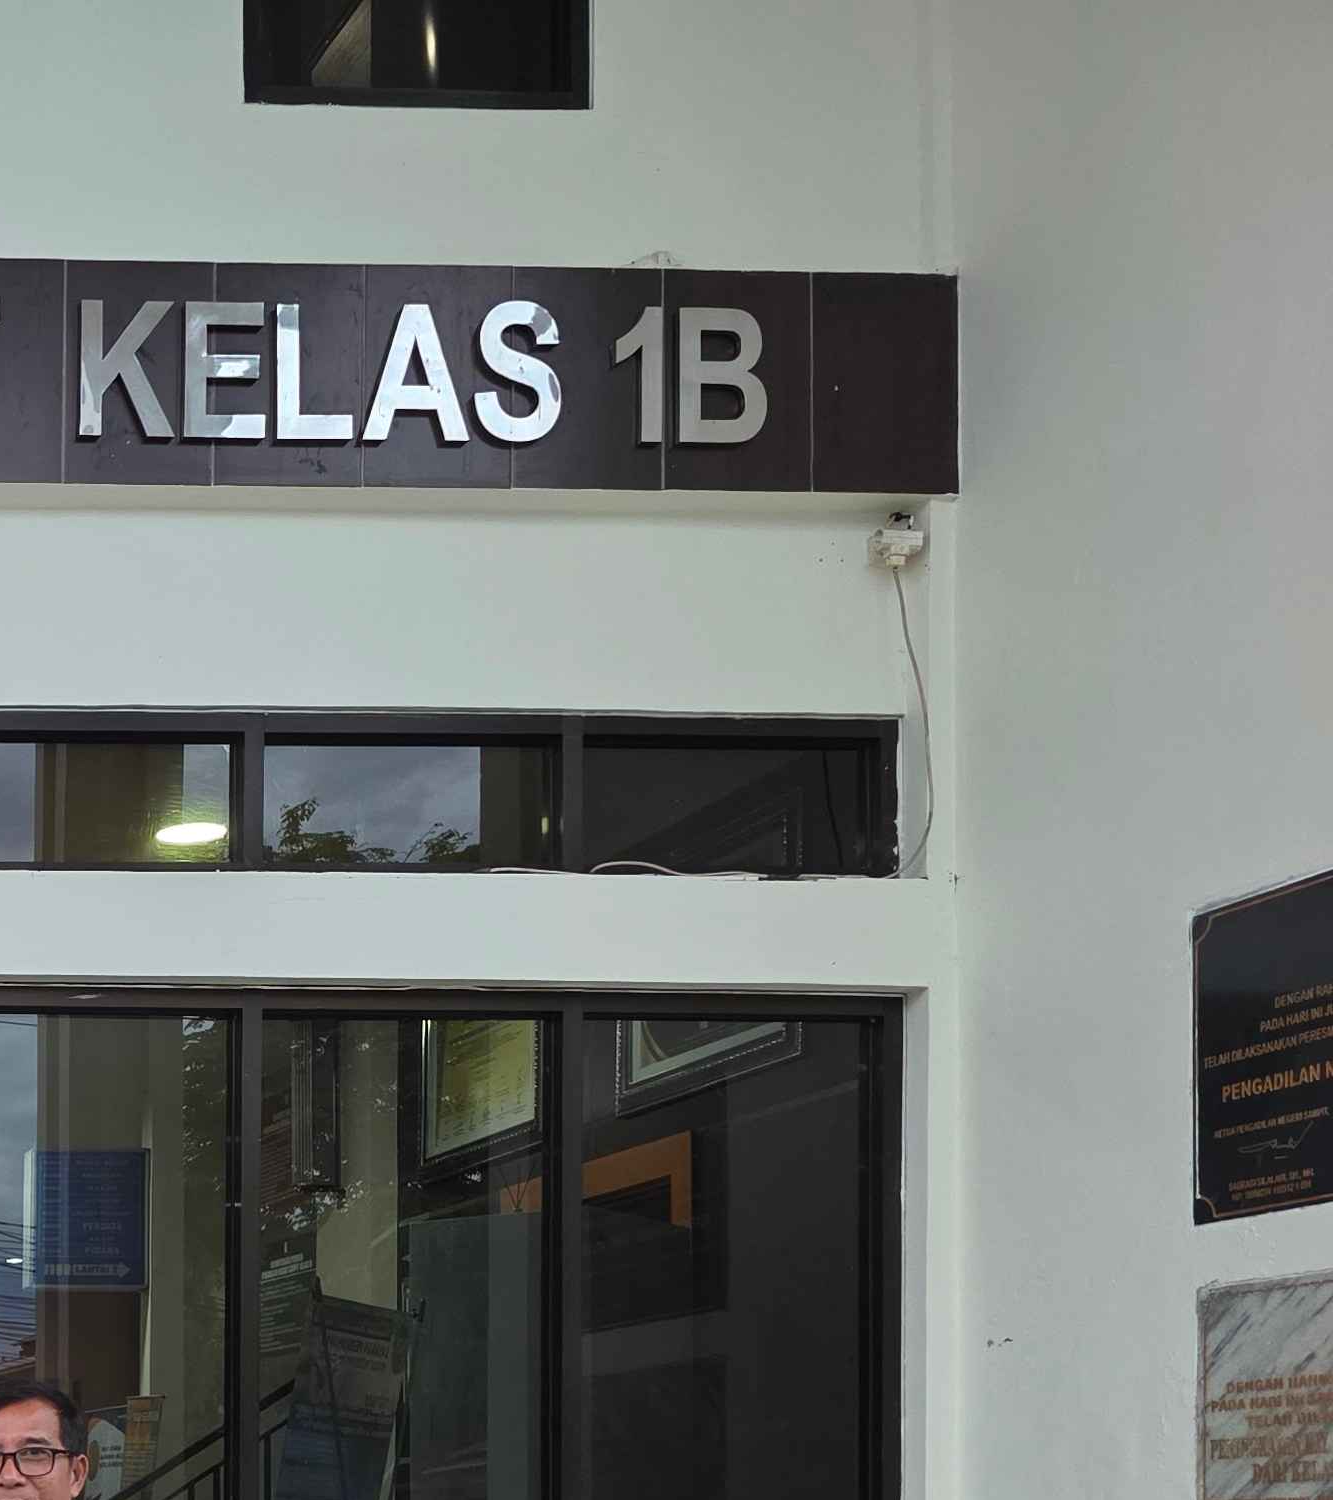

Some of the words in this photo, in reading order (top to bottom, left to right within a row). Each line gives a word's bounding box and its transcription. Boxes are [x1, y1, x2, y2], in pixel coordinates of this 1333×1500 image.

[77, 299, 562, 444] KELAS
[612, 305, 769, 446] 1B
[1260, 1017, 1285, 1032] PADA
[1204, 1049, 1231, 1070] TELAH
[1221, 1063, 1320, 1103] PENGADILAN
